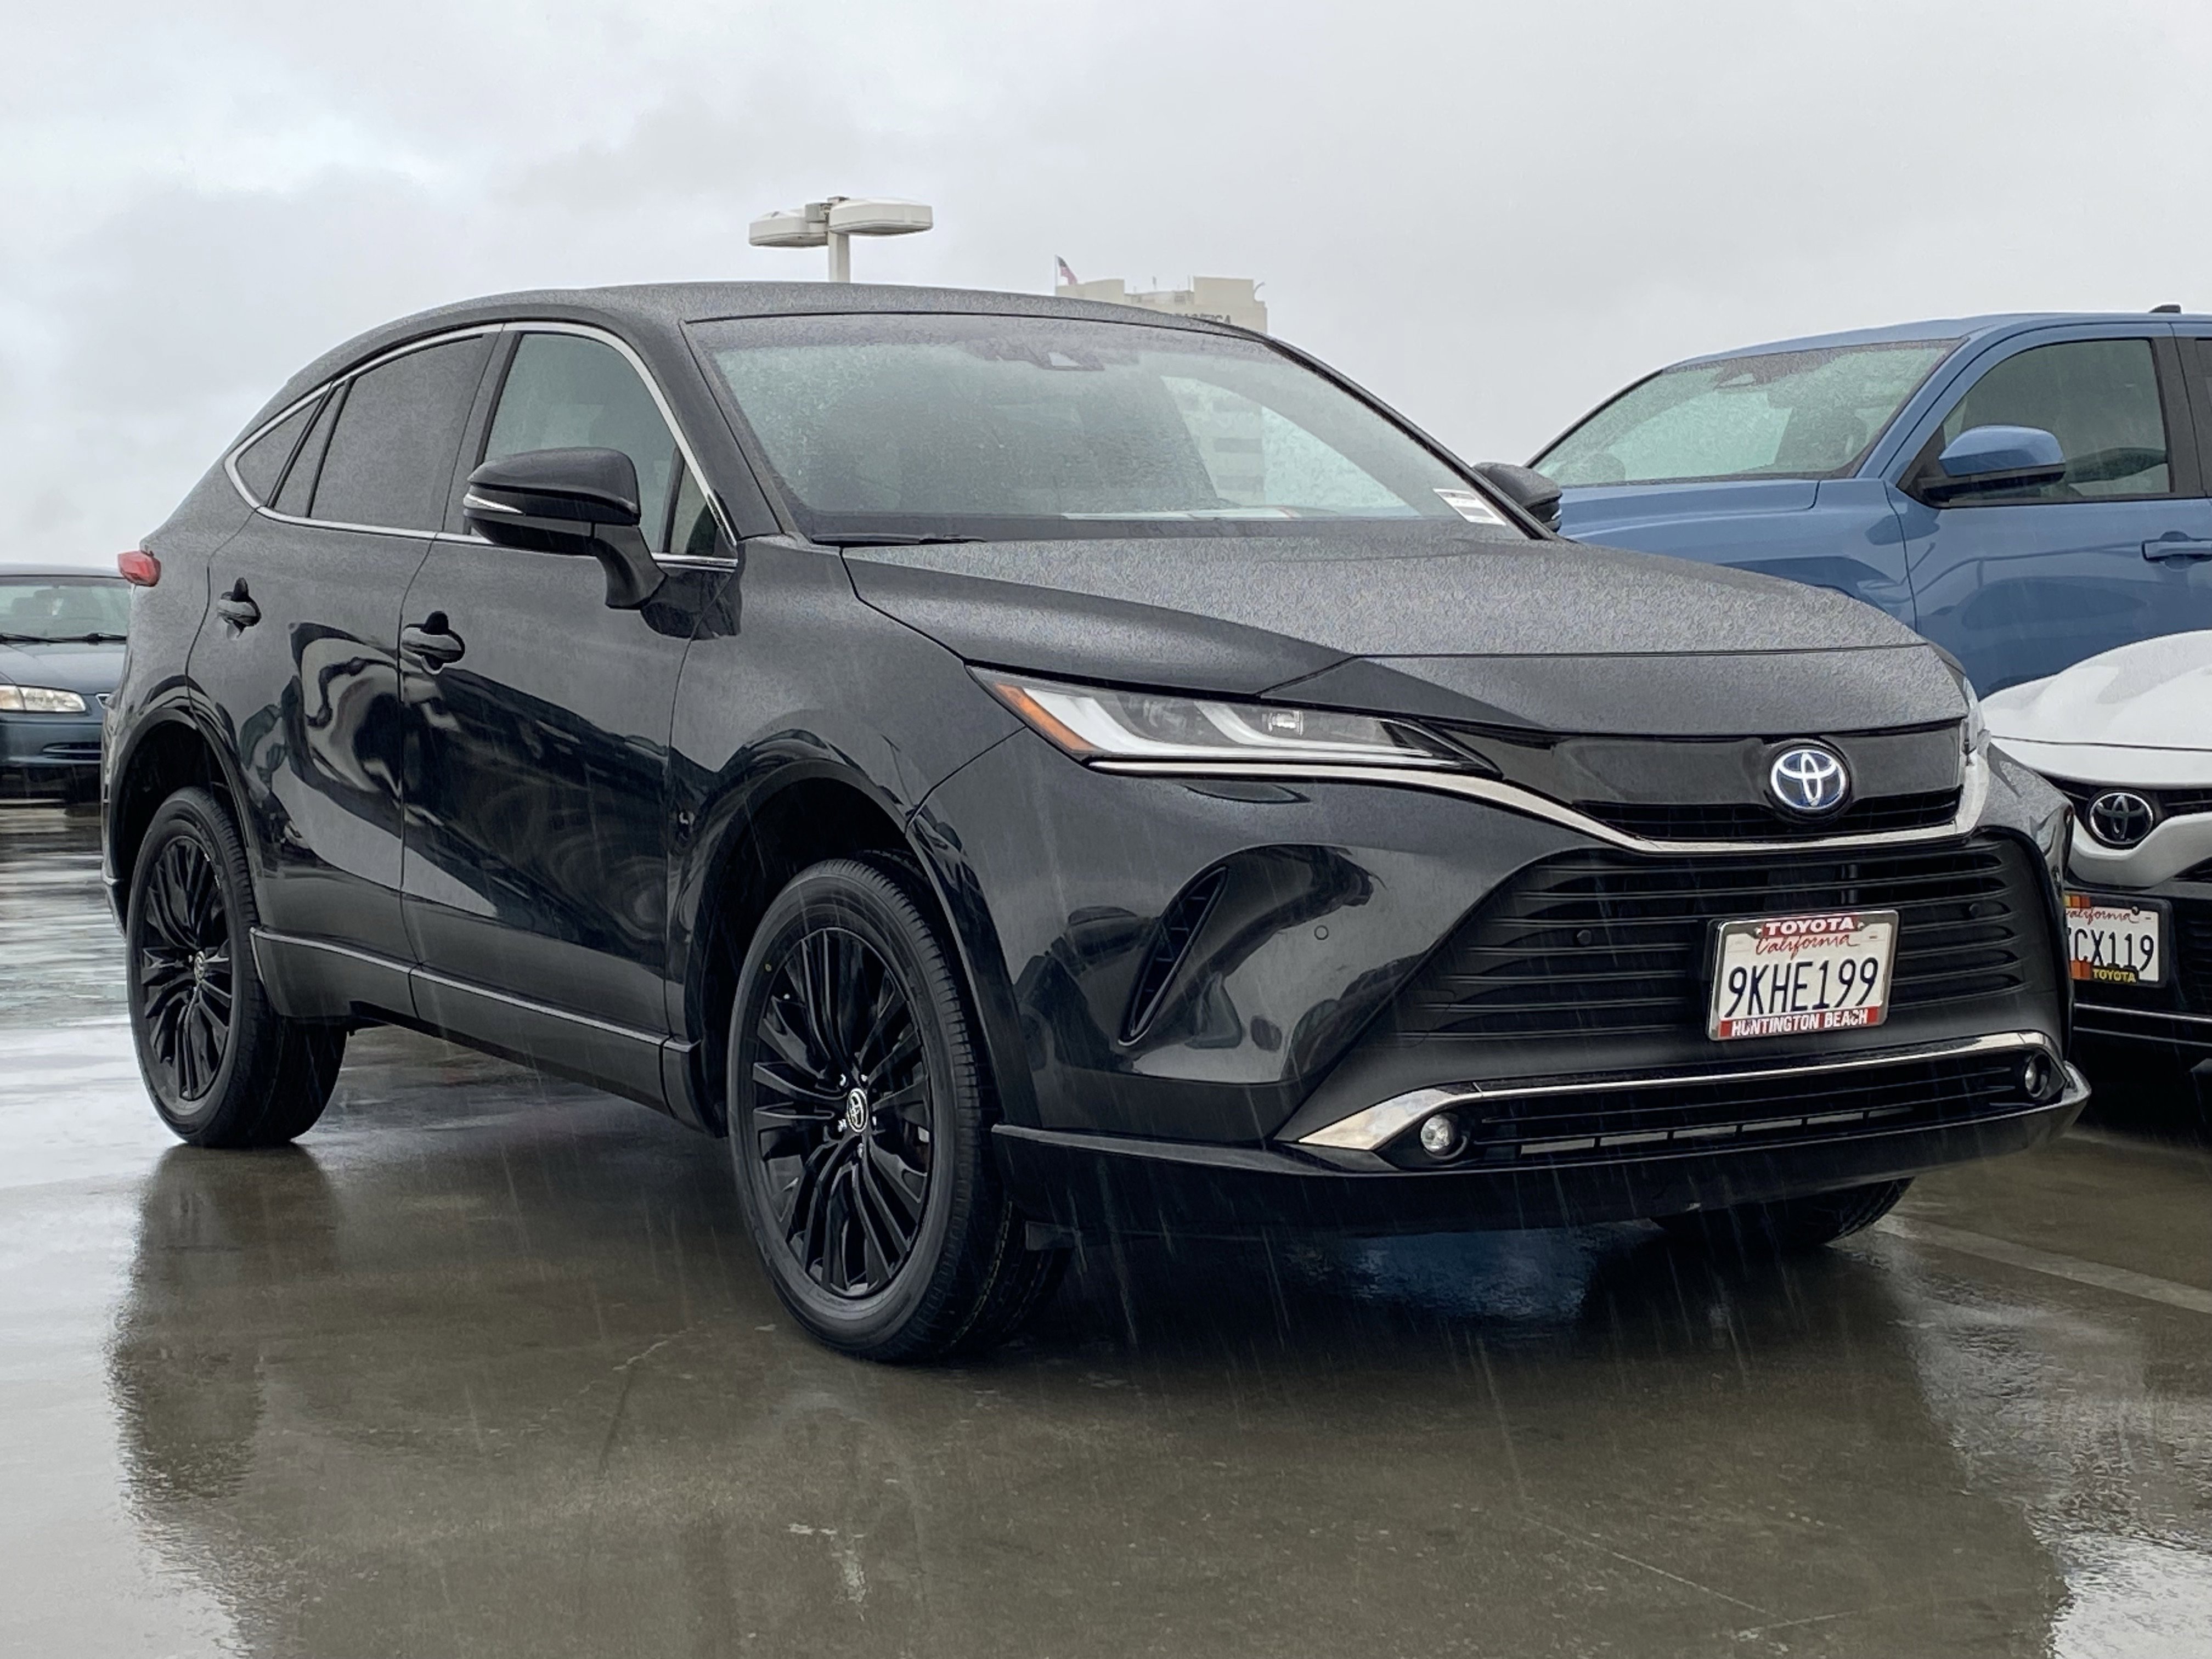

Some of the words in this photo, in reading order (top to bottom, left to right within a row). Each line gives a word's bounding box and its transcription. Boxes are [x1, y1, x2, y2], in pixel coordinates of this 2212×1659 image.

[1765, 917, 1854, 936] TOYOTA
[2067, 907, 2139, 924] alifornia
[1756, 933, 1860, 960] California
[2067, 927, 2154, 972] CX119
[1724, 957, 1879, 1018] 9KHE199
[2093, 968, 2137, 983] TOYOTA
[1731, 1013, 1820, 1037] HUNTINGTON
[1824, 1008, 1868, 1028] BEACH
